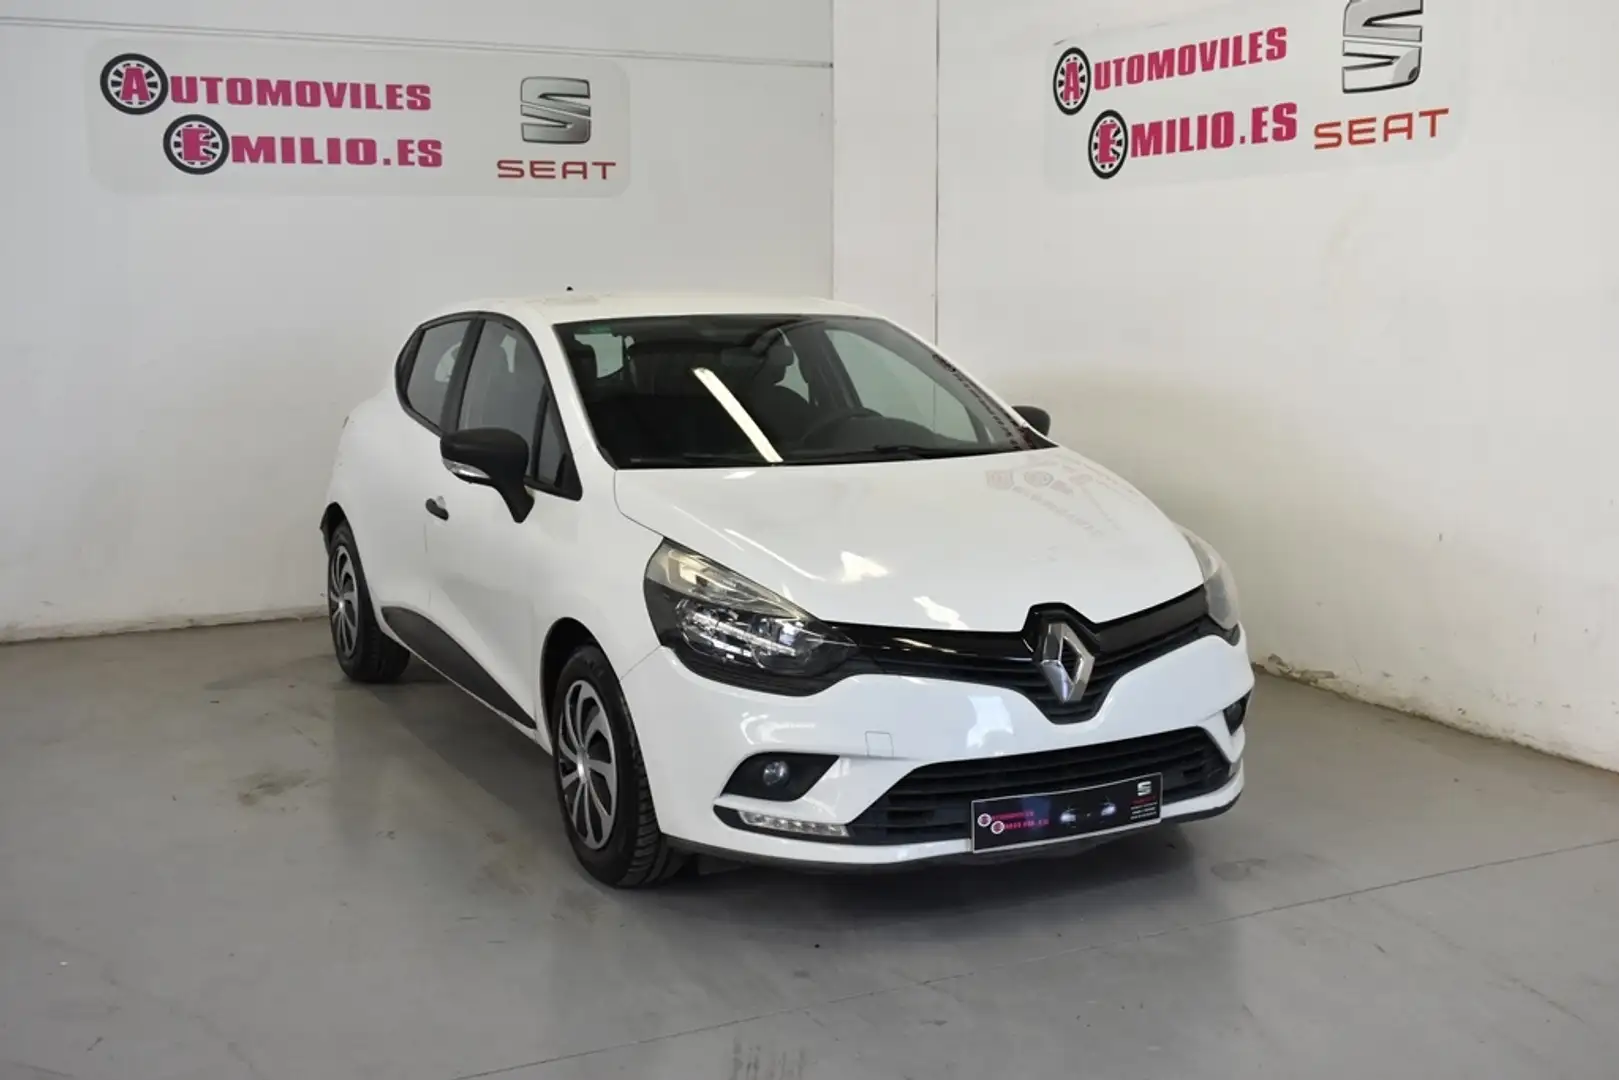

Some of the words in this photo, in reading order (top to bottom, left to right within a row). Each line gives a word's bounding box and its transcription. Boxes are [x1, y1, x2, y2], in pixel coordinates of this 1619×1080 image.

[1062, 26, 1288, 103] AUTOMOVILES
[119, 66, 432, 112] AUTOMOVILES
[179, 125, 443, 168] EMILIO.ES
[1096, 101, 1298, 165] EMILIO.ES
[1313, 107, 1450, 150] SEAT
[496, 159, 617, 181] SEAT
